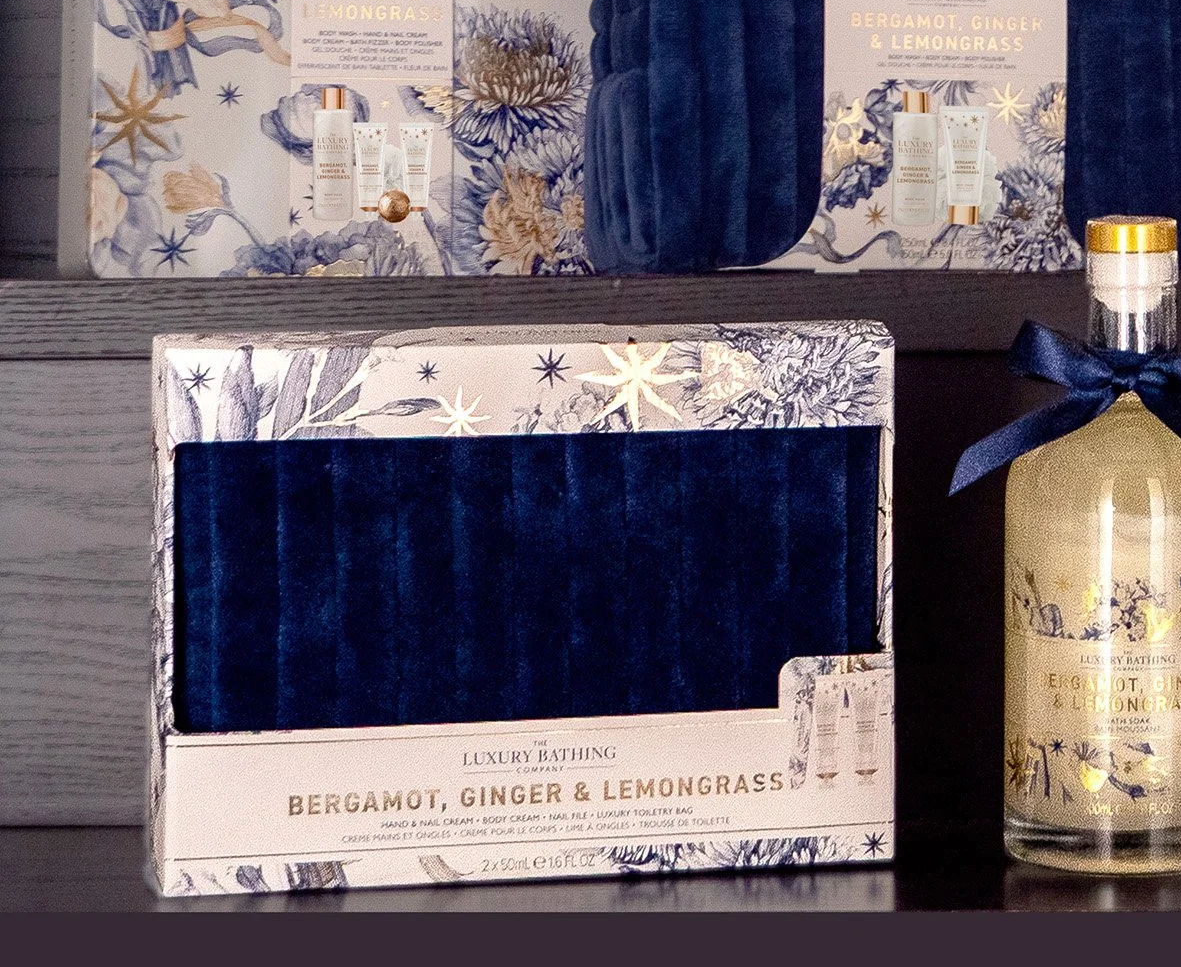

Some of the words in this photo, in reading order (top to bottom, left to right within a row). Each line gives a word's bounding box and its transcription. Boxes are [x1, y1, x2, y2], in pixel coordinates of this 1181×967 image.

[850, 13, 963, 31] BERGAMOT,
[971, 16, 1043, 31] GINGER
[870, 34, 882, 49] &
[890, 34, 1025, 51] LEMONGRASS
[462, 748, 531, 767] LUXURY
[538, 745, 617, 763] BATHING
[287, 787, 447, 816] BERGAMOT,
[460, 783, 561, 808] GINGER
[573, 781, 590, 802] &
[603, 773, 785, 800] LEMONGRASS
